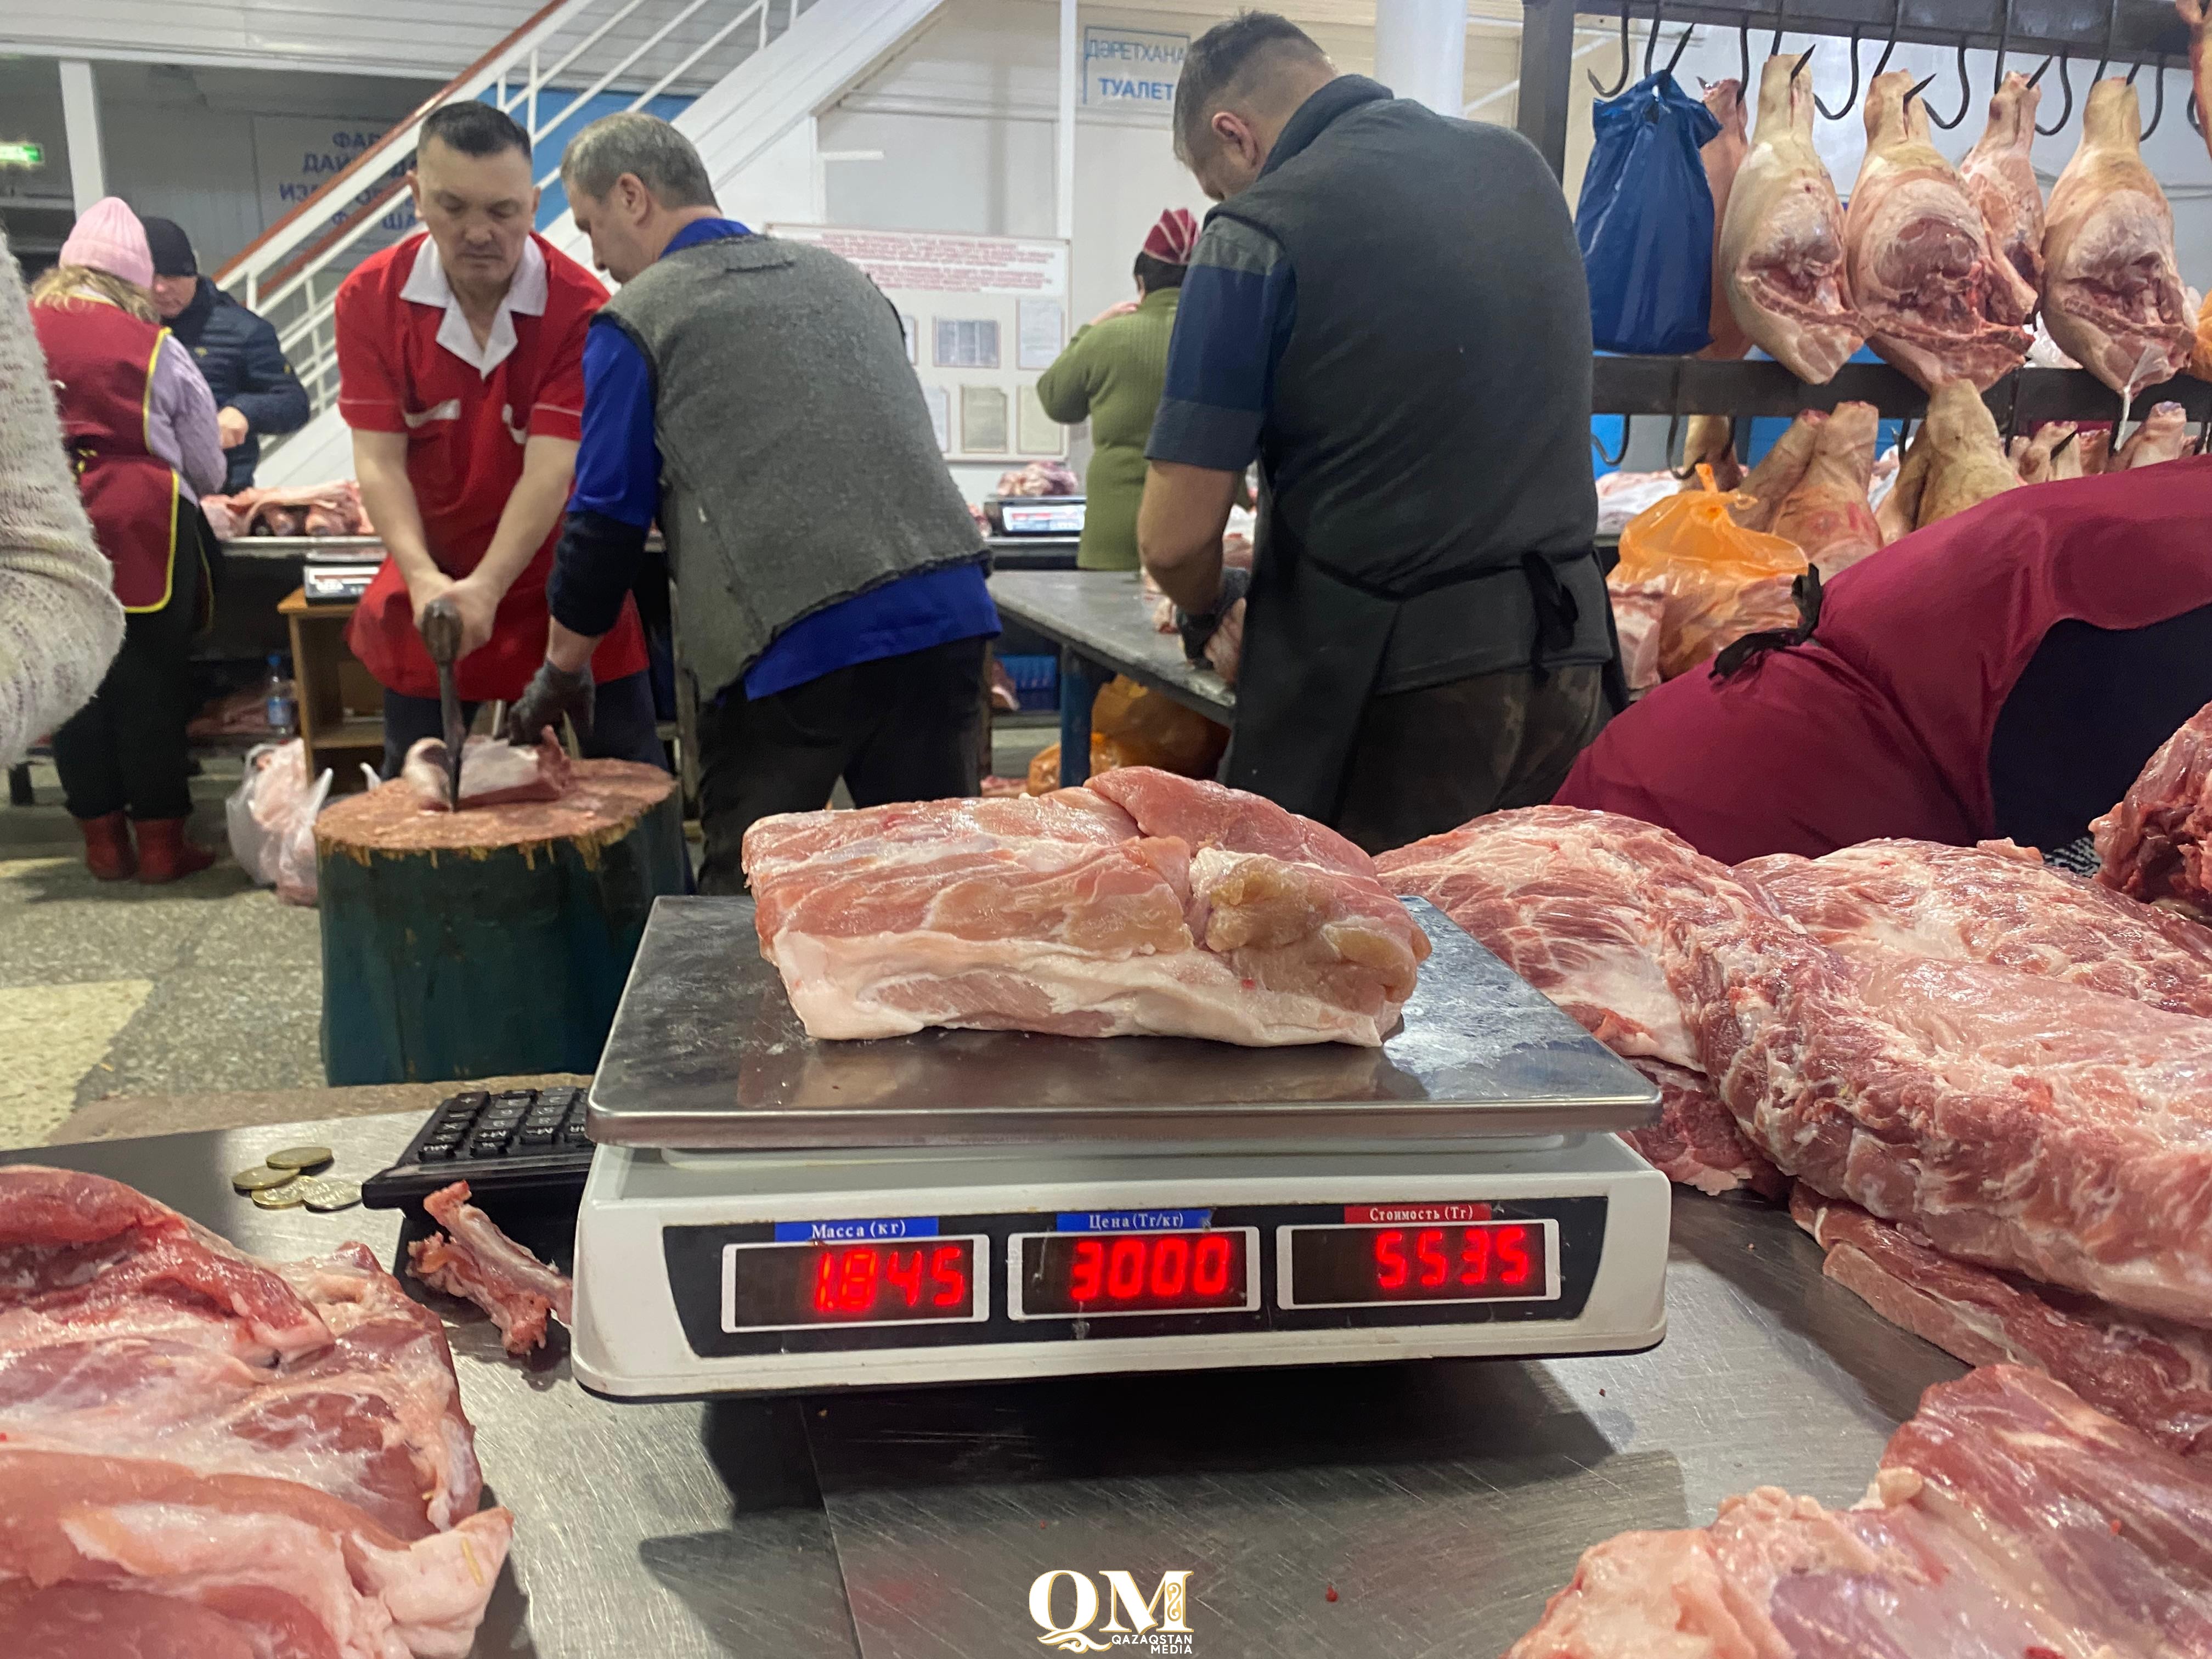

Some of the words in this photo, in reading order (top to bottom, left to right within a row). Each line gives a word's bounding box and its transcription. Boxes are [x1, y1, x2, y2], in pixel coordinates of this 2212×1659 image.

[1098, 78, 1173, 100] ТУАЛЕТ
[1369, 1207, 1440, 1221] Стоимость
[1444, 1204, 1473, 1221] (Тг)
[811, 1222, 865, 1239] Масса
[870, 1219, 906, 1238] (кг)
[1070, 1236, 1231, 1301] 3000
[1375, 1225, 1531, 1290] 5535
